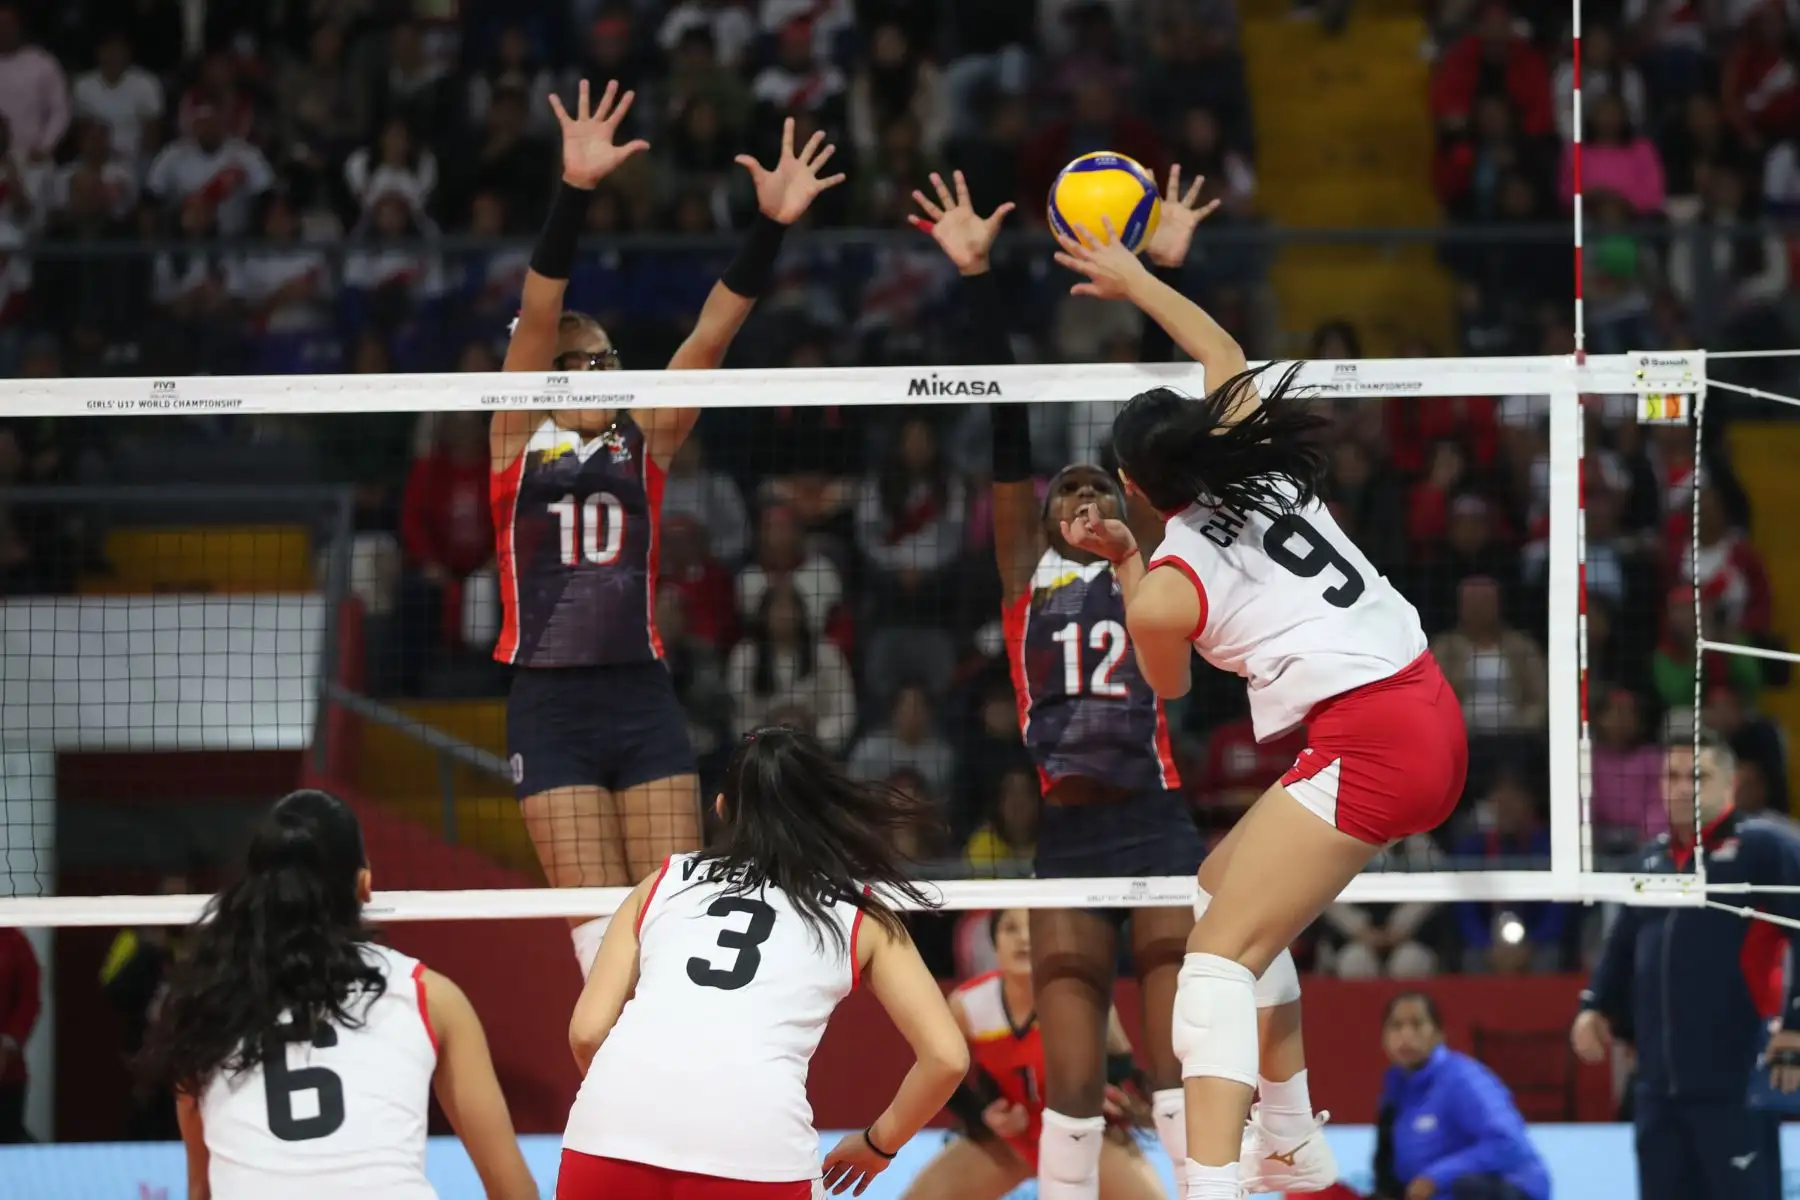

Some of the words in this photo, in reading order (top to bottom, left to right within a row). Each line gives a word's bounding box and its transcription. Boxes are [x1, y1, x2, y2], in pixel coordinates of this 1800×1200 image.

[117, 400, 135, 409] U17
[138, 400, 171, 409] WORLD
[172, 399, 243, 409] CHAMPIONSHIP
[547, 491, 625, 567] 10
[1262, 513, 1366, 609] 9
[1052, 619, 1130, 698] 12
[686, 895, 777, 991] 3
[262, 1018, 345, 1142] 6
